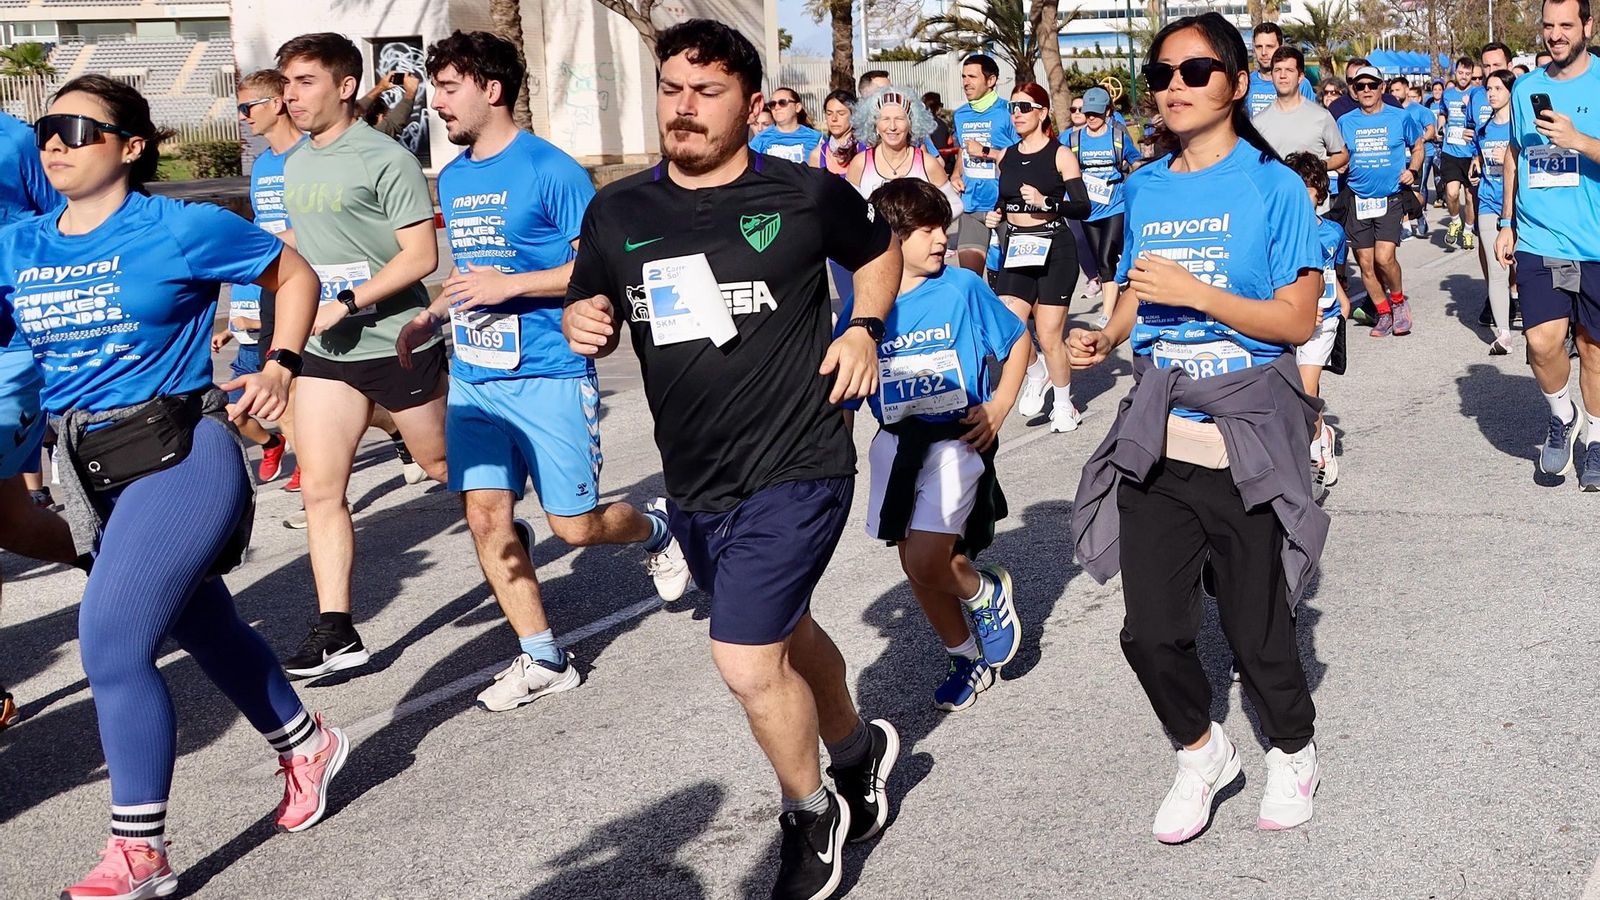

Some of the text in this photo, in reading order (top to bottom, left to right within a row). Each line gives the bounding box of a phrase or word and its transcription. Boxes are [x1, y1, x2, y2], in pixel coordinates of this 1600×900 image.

[1252, 93, 1278, 101] mayor
[962, 120, 992, 130] mayoral
[1355, 126, 1387, 136] mayoral
[1535, 158, 1567, 171] 1731
[257, 175, 285, 186] mayora
[452, 190, 508, 210] mayoral
[1006, 203, 1020, 212] PRO
[1142, 213, 1230, 239] mayoral
[1013, 244, 1040, 255] 2692
[17, 255, 120, 284] mayoral
[22, 296, 107, 322] MAKES
[465, 327, 504, 349] 1069
[881, 322, 951, 355] mayoral
[895, 372, 947, 400] 1732
